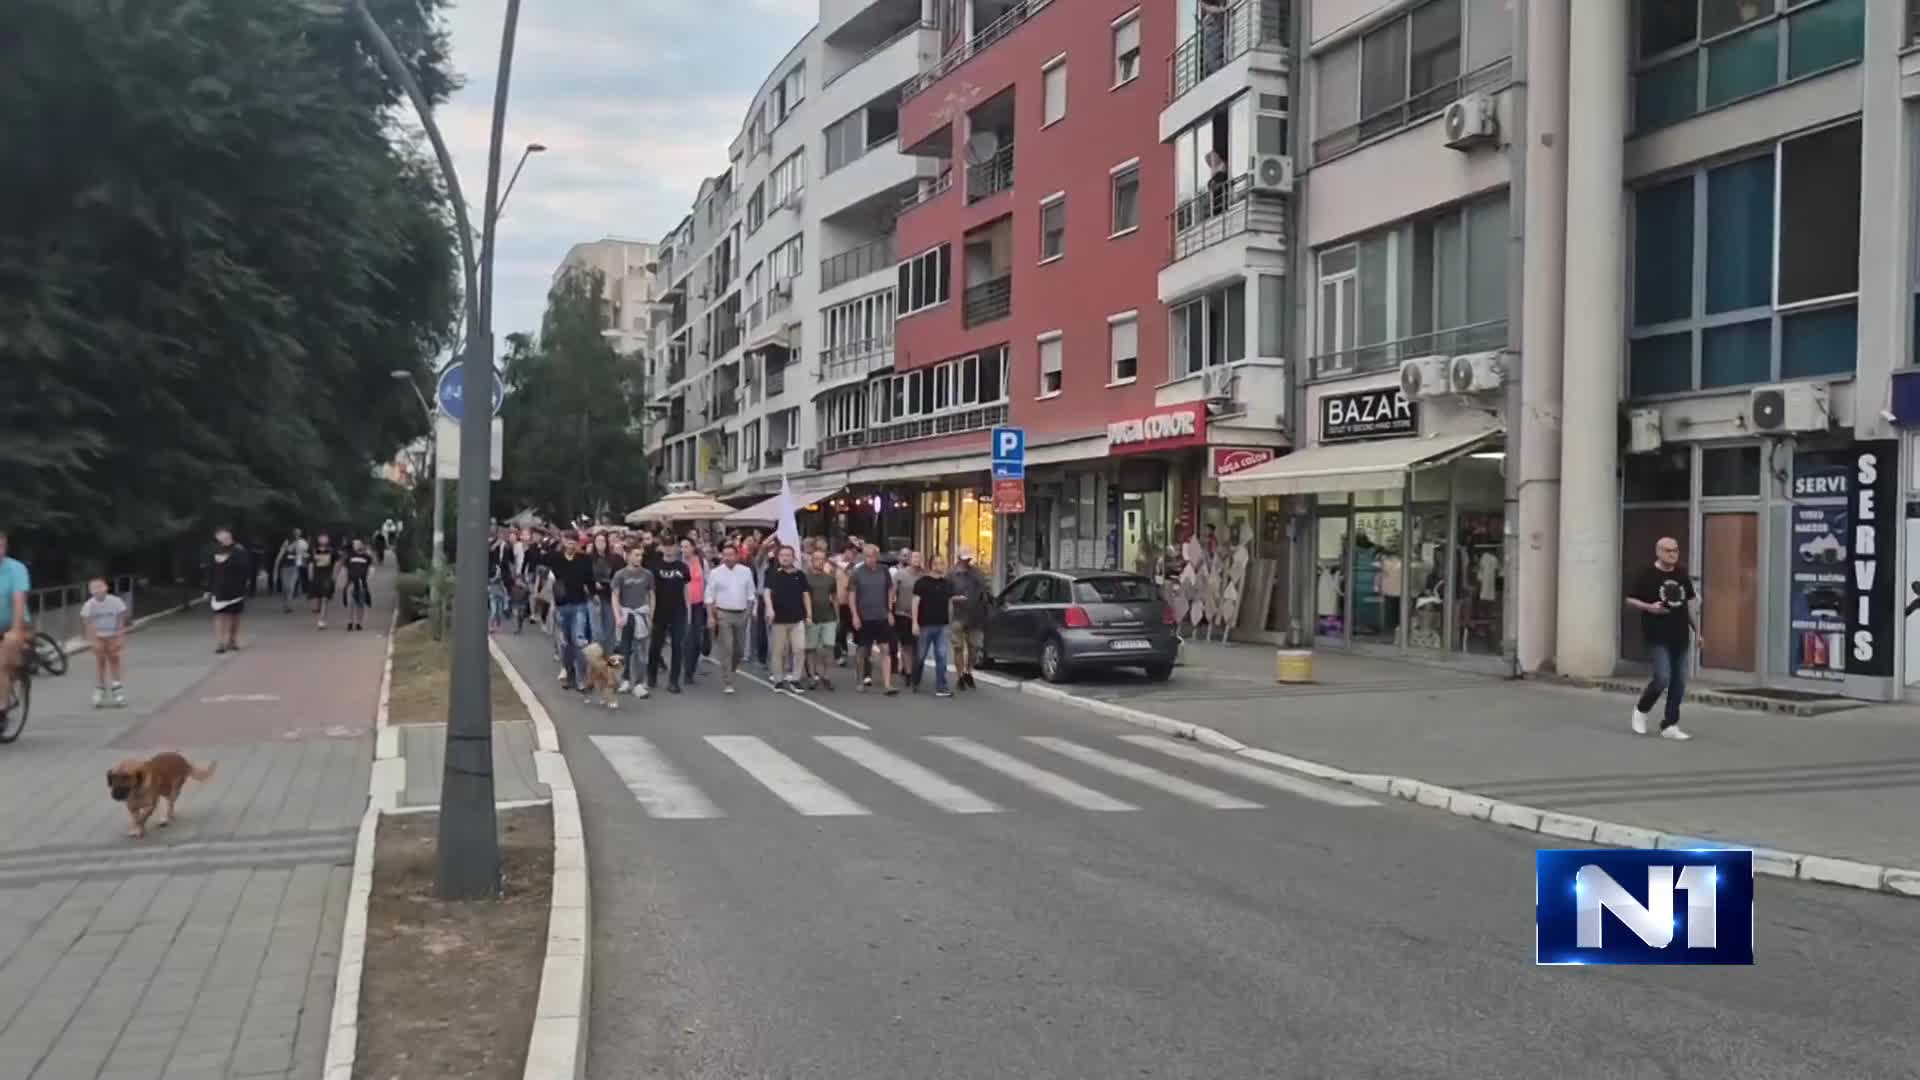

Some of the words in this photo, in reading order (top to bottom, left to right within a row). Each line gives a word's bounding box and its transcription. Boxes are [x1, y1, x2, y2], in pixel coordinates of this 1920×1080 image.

[1328, 391, 1411, 425] BAZAR
[1000, 431, 1018, 457] P
[1795, 475, 1848, 494] SERVI
[1853, 453, 1877, 662] SERVIS
